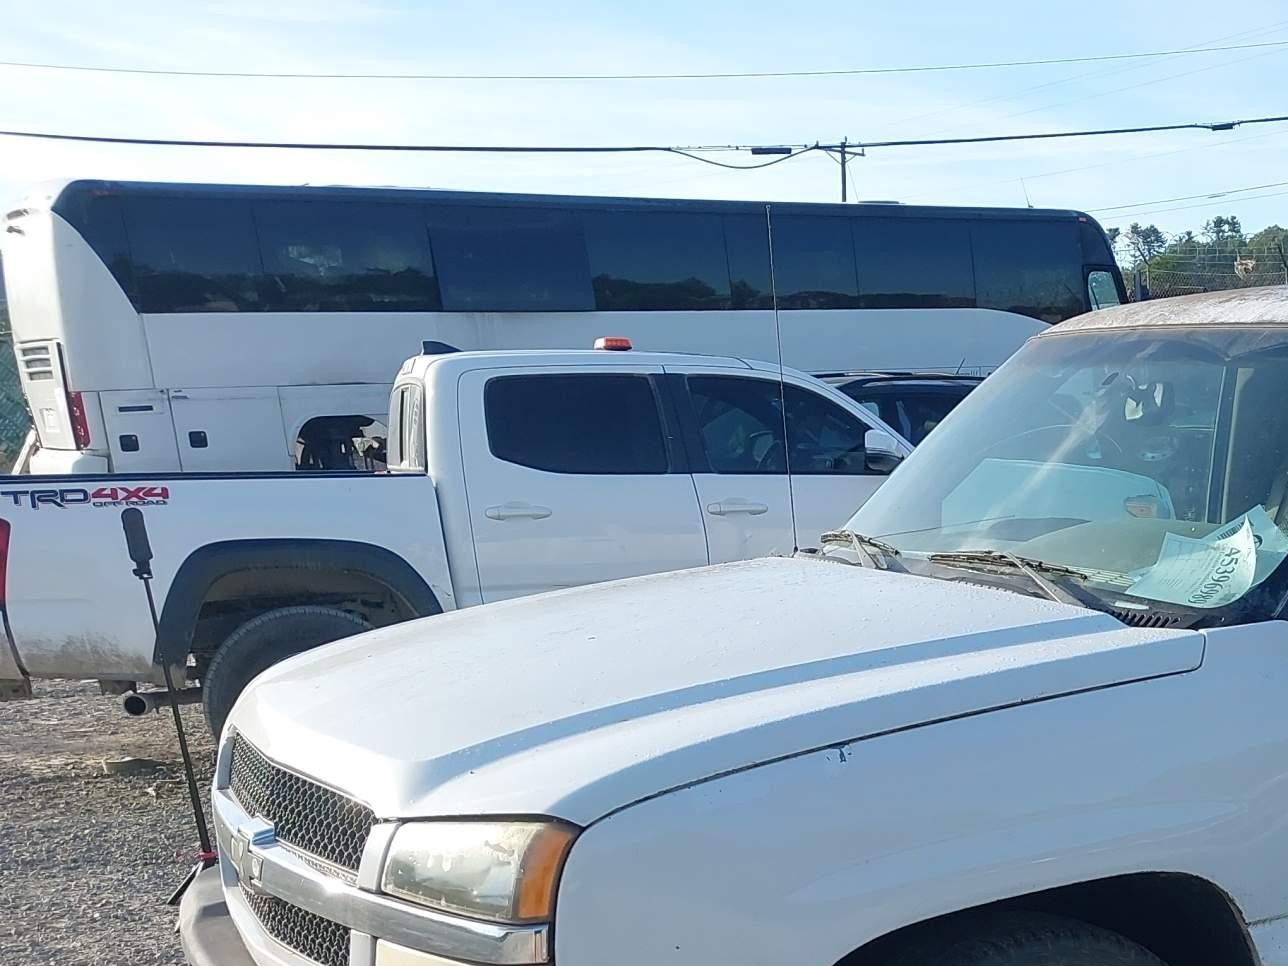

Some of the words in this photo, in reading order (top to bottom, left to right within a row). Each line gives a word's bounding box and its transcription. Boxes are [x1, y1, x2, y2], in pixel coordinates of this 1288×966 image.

[0, 488, 91, 510] TRD
[125, 499, 168, 507] ROAD
[1188, 547, 1241, 605] 45396989
